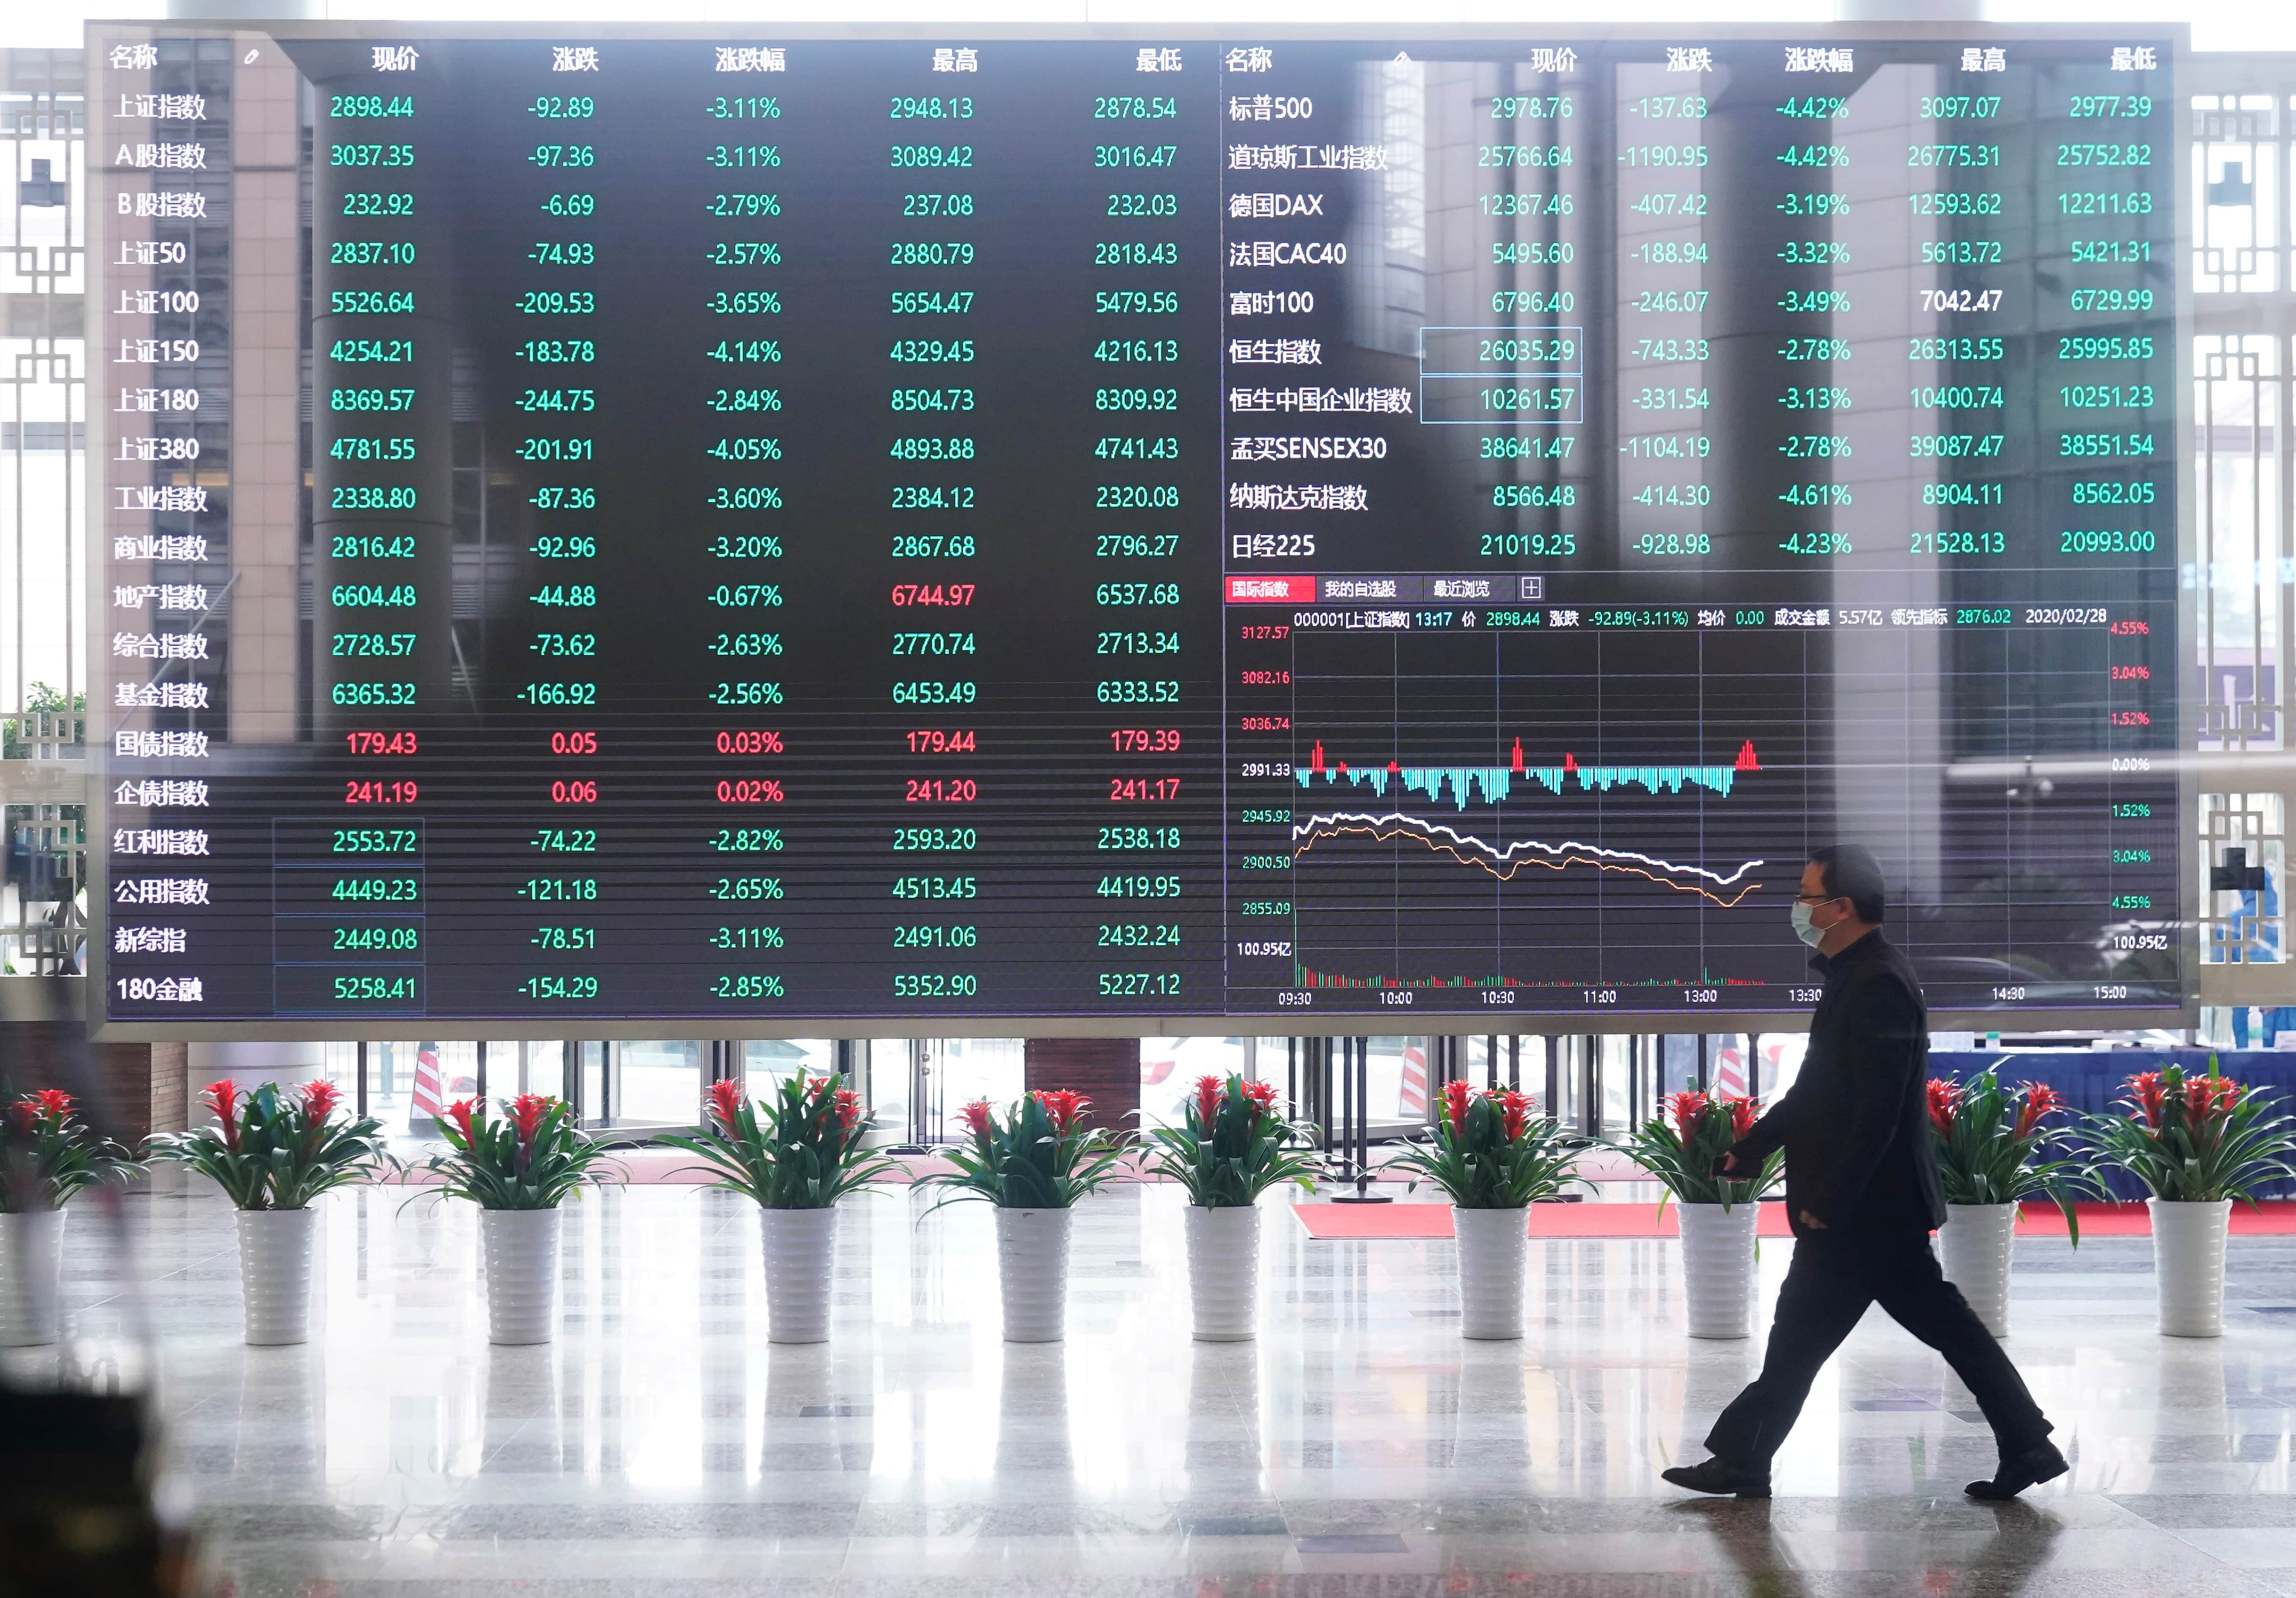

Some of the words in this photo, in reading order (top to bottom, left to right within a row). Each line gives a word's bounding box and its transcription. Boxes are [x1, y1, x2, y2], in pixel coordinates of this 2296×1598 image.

[109, 43, 158, 70] 名称
[371, 46, 420, 72] 现价
[552, 46, 599, 72] 涨跌
[715, 47, 786, 72] 涨跌幅
[932, 47, 978, 72] 最高
[1136, 47, 1182, 72] 最低
[1225, 46, 1272, 72] 名称
[1531, 47, 1578, 73] 现价
[1666, 47, 1713, 72] 涨跌
[1785, 47, 1854, 73] 涨跌幅
[1960, 47, 2006, 72] 最高
[2110, 46, 2157, 71] 最低
[113, 94, 207, 120] 上证指数
[1229, 93, 1312, 121] 标普500
[330, 144, 415, 167] 3037.35
[527, 144, 595, 168] -97.36
[705, 145, 782, 168] -3.11%
[890, 145, 973, 168] 3089.42
[1094, 144, 1178, 168] 3016.47
[1228, 144, 1388, 171] 道琼斯工业指数
[1478, 144, 1573, 170] 25766.64
[1615, 144, 1710, 168] -1190.95
[1775, 145, 1849, 168] -4.42%
[1908, 144, 2001, 168] 26775.31
[2056, 143, 2151, 167] 25752.82
[1228, 193, 1324, 218] 德国DAX
[113, 241, 186, 265] 上证50
[330, 242, 416, 265] 2837.10
[528, 242, 595, 265] -74.93
[706, 242, 782, 266] -2.57%
[890, 242, 975, 266] 2880.79
[1094, 242, 1178, 266] 2818.43
[1229, 242, 1347, 267] 法国CAC40
[1493, 241, 1574, 265] 5495.60
[1631, 241, 1710, 264] -188.94
[1776, 241, 1849, 264] -3.32%
[1922, 240, 2003, 264] 5613.72
[2071, 240, 2151, 263] 5421.31
[113, 290, 199, 314] 上证100
[1229, 290, 1314, 316] 富时100
[113, 339, 199, 363] 上证150
[329, 339, 413, 363] 4254.21
[515, 340, 595, 363] -183.78
[707, 340, 782, 363] -4.14%
[890, 340, 976, 363] 4329.45
[1093, 339, 1179, 363] 4216.13
[1229, 339, 1322, 365] 恒生指数
[1479, 338, 1575, 363] 26035.29
[1631, 338, 1710, 361] -743.33
[1777, 338, 1851, 362] -2.78%
[1910, 337, 2005, 361] 26313.55
[2058, 336, 2154, 360] 25995.85
[113, 388, 199, 412] 上证180
[1229, 387, 1413, 414] 恒生中国企业指数
[113, 437, 199, 461] 上证380
[329, 437, 416, 461] 4781.55
[515, 438, 593, 461] -201.91
[706, 437, 783, 461] -4.05%
[889, 437, 976, 460] 4893.88
[1094, 437, 1180, 459] 4741.43
[1231, 437, 1387, 461] 孟买SENSEX30
[1480, 436, 1574, 460] 38641.47
[1619, 434, 1712, 459] -1104.19
[1777, 435, 1852, 458] -2.78%
[1910, 434, 2005, 458] 39087.47
[2059, 433, 2155, 457] 38551.54
[115, 486, 208, 512] 工业指数
[1230, 482, 1368, 511] 纳斯达克指数
[115, 535, 208, 561] 商业指数
[331, 535, 416, 558] 2816.42
[529, 536, 597, 558] -92.96
[707, 535, 784, 558] -3.20%
[891, 535, 976, 558] 2867.68
[1095, 534, 1180, 557] 2796.27
[1233, 533, 1315, 558] 日经225
[1480, 533, 1576, 556] 21019.25
[1633, 532, 1713, 556] -928.98
[1778, 532, 1852, 555] -4.23%
[1910, 530, 2006, 554] 21528.13
[2059, 530, 2156, 553] 20993.00
[113, 584, 209, 611] 地产指数
[1231, 581, 1290, 598] 国际指数
[1325, 580, 1397, 597] 我的自选股
[1433, 580, 1490, 598] 最近浏览
[1416, 611, 1453, 627] 13:17
[1462, 611, 1476, 627] 价
[1487, 611, 1540, 626] 2898.44
[1549, 610, 1579, 627] 涨跌
[1697, 609, 1726, 626] 均价
[1735, 611, 1765, 625] 0.00
[1774, 608, 1831, 626] 成交金额
[1839, 609, 1883, 626] 5.57亿
[1891, 608, 1948, 625] 领先指标
[1957, 609, 2011, 624] 2876.02
[2026, 608, 2107, 625] 2020/02/28
[2110, 621, 2149, 635] 4.55%
[1242, 626, 1290, 639] 3127.57
[113, 632, 209, 659] 综合指数
[331, 633, 417, 656] 2728.57
[529, 633, 596, 656] -73.62
[707, 632, 784, 656] -2.63%
[892, 632, 976, 655] 2770.74
[1096, 631, 1181, 654] 2713.34
[1243, 671, 1290, 684] 3082.16
[2112, 666, 2149, 679] 3.04%
[115, 682, 209, 709] 基金指数
[1242, 717, 1290, 730] 3036.74
[2112, 712, 2150, 726] 1.52%
[115, 730, 209, 757] 国债指数
[346, 731, 418, 755] 179.43
[551, 731, 598, 754] 0.05
[716, 731, 784, 754] 0.03%
[906, 730, 977, 753] 179.44
[1110, 729, 1181, 752] 179.39
[1242, 763, 1290, 776] 2991.33
[2112, 757, 2150, 771] 0.00%
[114, 780, 209, 807] 企债指数
[1243, 809, 1290, 823] 2945.92
[2113, 803, 2151, 818] 1.52%
[114, 828, 210, 856] 红利指数
[332, 829, 417, 852] 2553.72
[530, 829, 597, 852] -74.22
[709, 828, 784, 851] -2.82%
[892, 827, 977, 851] 2593.20
[1097, 826, 1181, 849] 2538.18
[1242, 856, 1290, 869] 2900.50
[2113, 850, 2150, 863] 3.04%
[114, 878, 210, 905] 公用指数
[2112, 895, 2151, 909] 4.55%
[1243, 901, 1290, 915] 2855.09
[114, 926, 186, 953] 新综指
[333, 927, 418, 950] 2449.08
[530, 927, 595, 950] -78.51
[709, 926, 785, 949] -3.11%
[893, 925, 977, 948] 2491.06
[1237, 942, 1292, 957] 100.95亿
[2114, 935, 2168, 950] 100.95亿
[117, 977, 203, 1002] 180金融
[1279, 992, 1311, 1005] 09:30
[1379, 991, 1412, 1004] 10:00
[1482, 990, 1515, 1004] 10:30
[1584, 990, 1616, 1003] 11:00
[1684, 989, 1717, 1002] 13:00
[1789, 988, 1822, 1002] 13:30
[1992, 987, 2024, 1000] 14:30
[2094, 985, 2127, 999] 15:00
